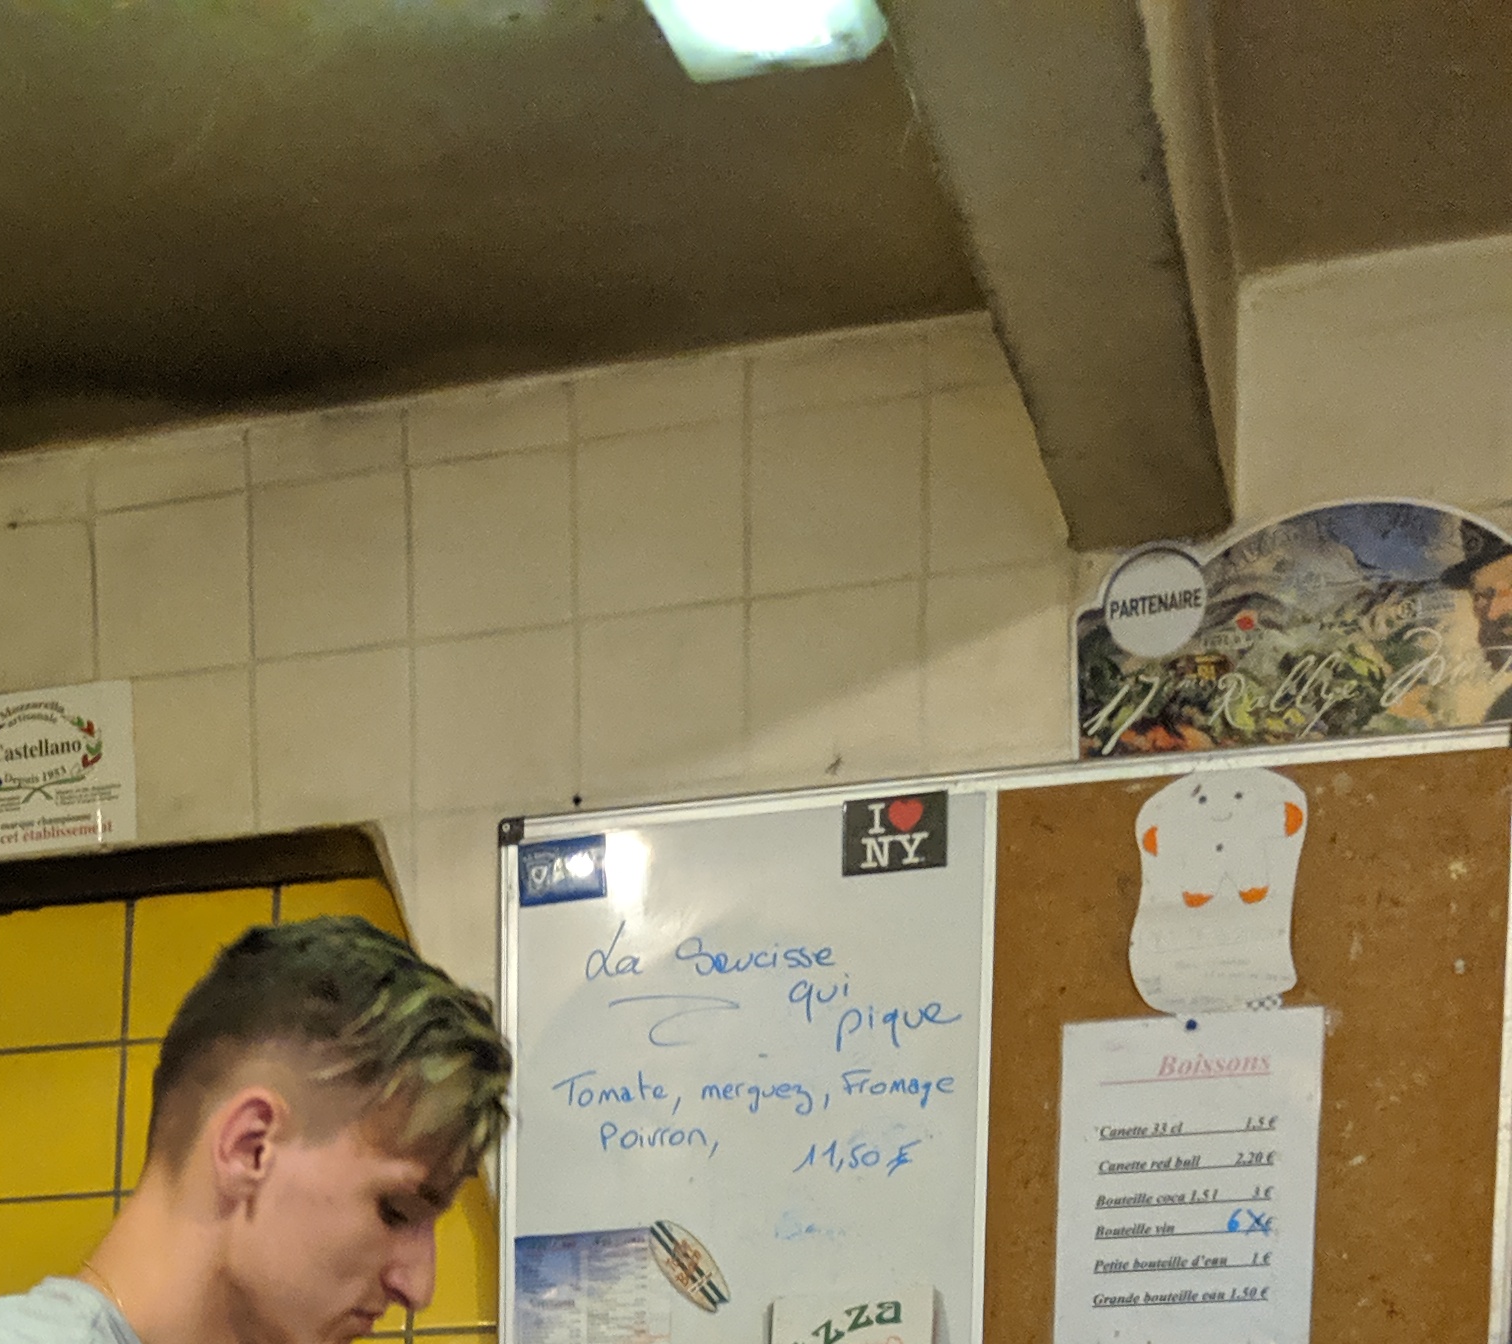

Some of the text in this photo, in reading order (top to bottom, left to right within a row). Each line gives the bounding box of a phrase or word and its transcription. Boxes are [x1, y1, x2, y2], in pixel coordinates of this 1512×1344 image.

[1109, 588, 1202, 620] PARTENAIRE
[867, 802, 886, 836] I
[0, 831, 19, 845] cet
[860, 831, 930, 870] NY
[585, 920, 644, 980] La
[788, 973, 850, 1023] qui
[835, 1000, 963, 1052] pique
[1157, 1051, 1271, 1078] Boissons
[552, 1068, 955, 1116] Tomate, merguez, Fromage
[1099, 1125, 1149, 1139] Canette
[1098, 1159, 1146, 1174] Canette
[1150, 1156, 1173, 1171] red
[1174, 1154, 1202, 1170] bull
[1095, 1193, 1155, 1208] Bouteille
[1095, 1221, 1176, 1238] Bouteille vin
[1094, 1258, 1130, 1273] Petite
[1132, 1255, 1189, 1271] bouteille
[1092, 1292, 1141, 1306] Grande
[1143, 1289, 1199, 1305] bouteille
[1201, 1290, 1226, 1302] eau
